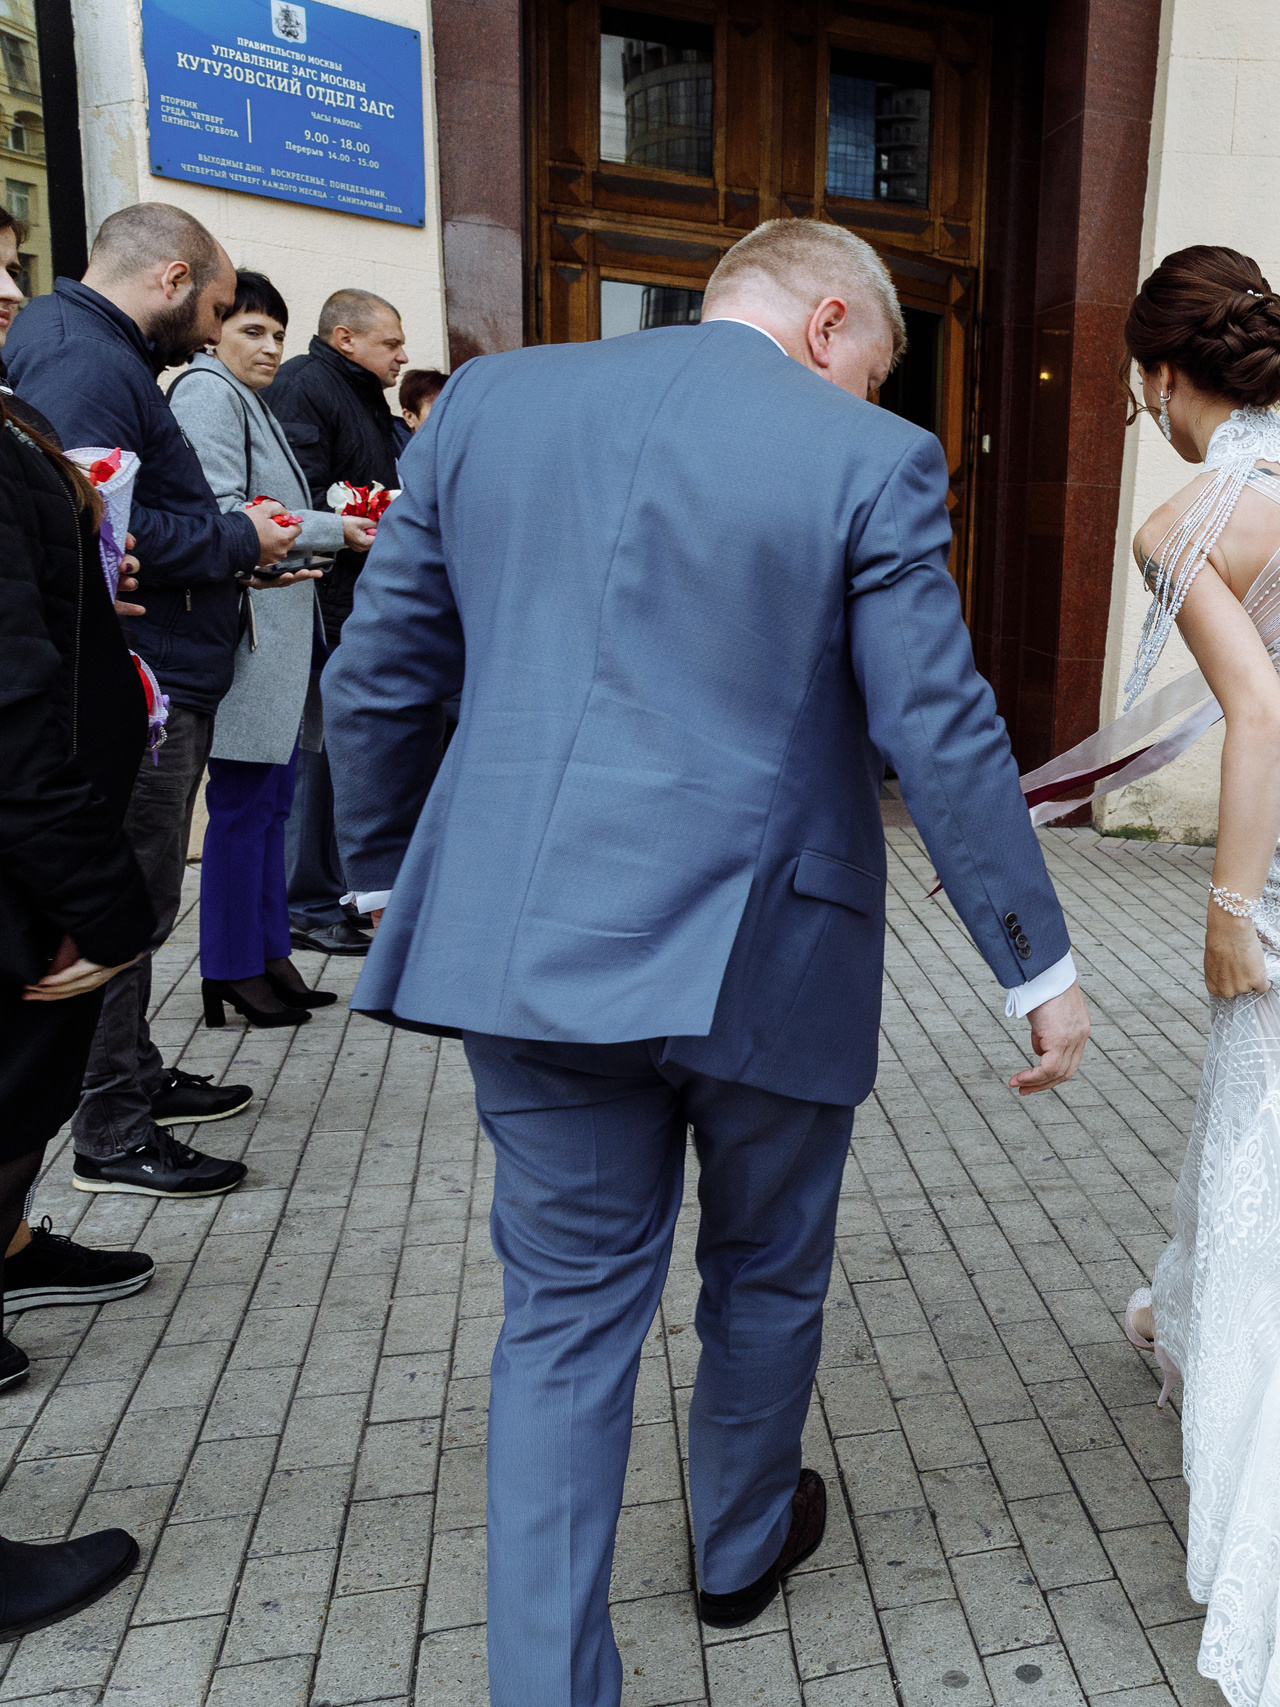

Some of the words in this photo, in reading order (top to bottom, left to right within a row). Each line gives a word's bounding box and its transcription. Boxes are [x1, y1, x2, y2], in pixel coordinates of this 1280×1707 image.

[237, 37, 306, 61] ПРАВИТЕЛЬСТВО
[308, 55, 342, 71] МОСКВЫ
[211, 44, 289, 73] УПРАВЛЕНИЕ
[292, 65, 318, 80] ЗАГС
[320, 72, 366, 93] МОСКВЫ
[177, 52, 301, 96] КУТУЗОВСКИЙ
[306, 84, 355, 109] ОТДЕЛ
[360, 97, 394, 118] ЗАГС
[160, 94, 197, 109] ВТОРНИК
[191, 111, 224, 124] ЧЕТВЕРГ
[311, 112, 331, 122] ЧАСЫ
[333, 117, 363, 130] РАБОТЫ:
[205, 124, 239, 137] СУББОТА
[304, 130, 329, 144] 9.00
[340, 138, 370, 154] 18.00
[198, 154, 243, 169] ВЫХОДНЫЕ
[245, 163, 264, 173] ДНИ:
[285, 141, 323, 157] Перерыв
[328, 151, 350, 162] 14.00
[358, 158, 379, 169] 15.00
[181, 163, 227, 178] ЧЕТВЕРТЫЙ
[229, 173, 260, 185] ЧЕТВЕРГ
[262, 180, 297, 192] КАЖДОГО
[299, 187, 327, 198] МЕСЯЦА
[338, 195, 384, 210] САНИТАРНЫЙ
[385, 205, 402, 213] ДЕНЬ
